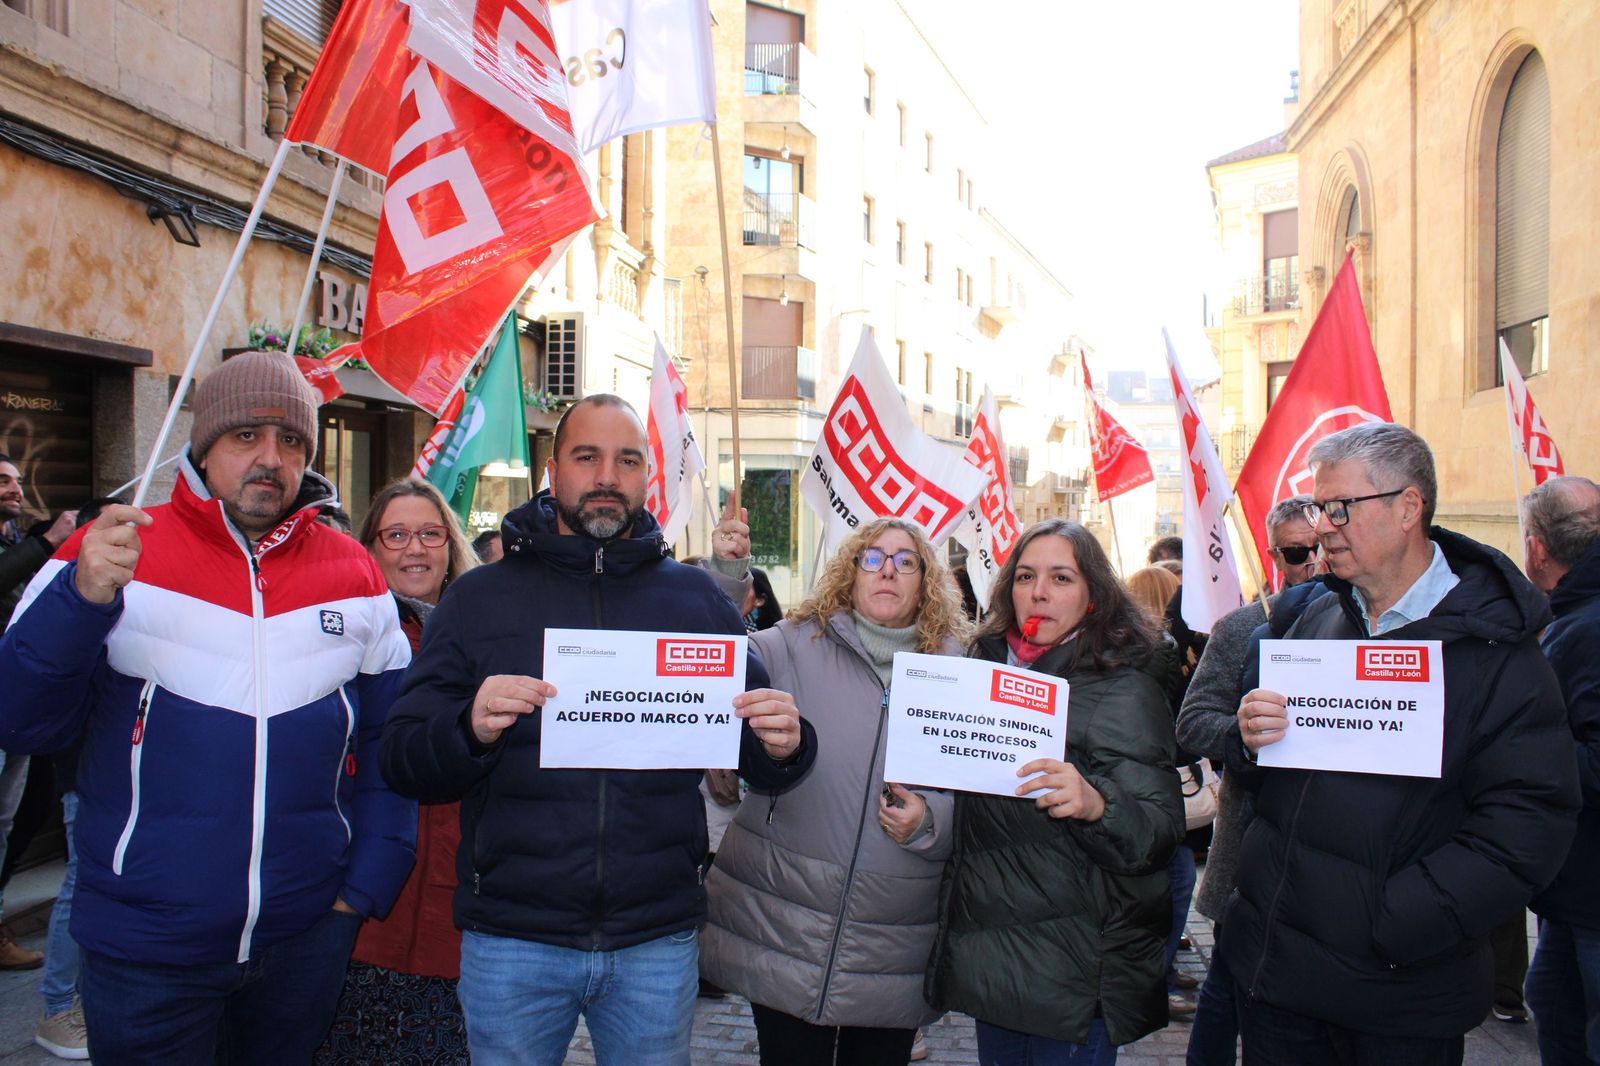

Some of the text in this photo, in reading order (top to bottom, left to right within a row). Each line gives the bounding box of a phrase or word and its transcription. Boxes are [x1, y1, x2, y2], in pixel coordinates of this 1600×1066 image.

[830, 393, 950, 541] CCOO
[670, 647, 722, 660] CCOO
[1369, 653, 1417, 666] CCOO
[665, 664, 696, 673] Castilla
[705, 664, 726, 673] León
[1365, 669, 1394, 677] Castilla
[1402, 669, 1422, 678] León
[1003, 678, 1046, 698] CCOO
[585, 690, 705, 704] ¡NEGOCIACIÓN
[999, 692, 1025, 704] Castilla
[1032, 698, 1049, 710] León
[1284, 696, 1417, 711] NEGOCIACIÓN DE
[556, 711, 730, 725] ACUERDO MARCO YA!
[906, 707, 1053, 738] OBSERVACIÓN SINDICAL
[1296, 716, 1403, 732] CONVENIO YA!
[923, 726, 1037, 749] EN LOS PROCESOS
[940, 744, 1016, 763] SELECTIVOS
